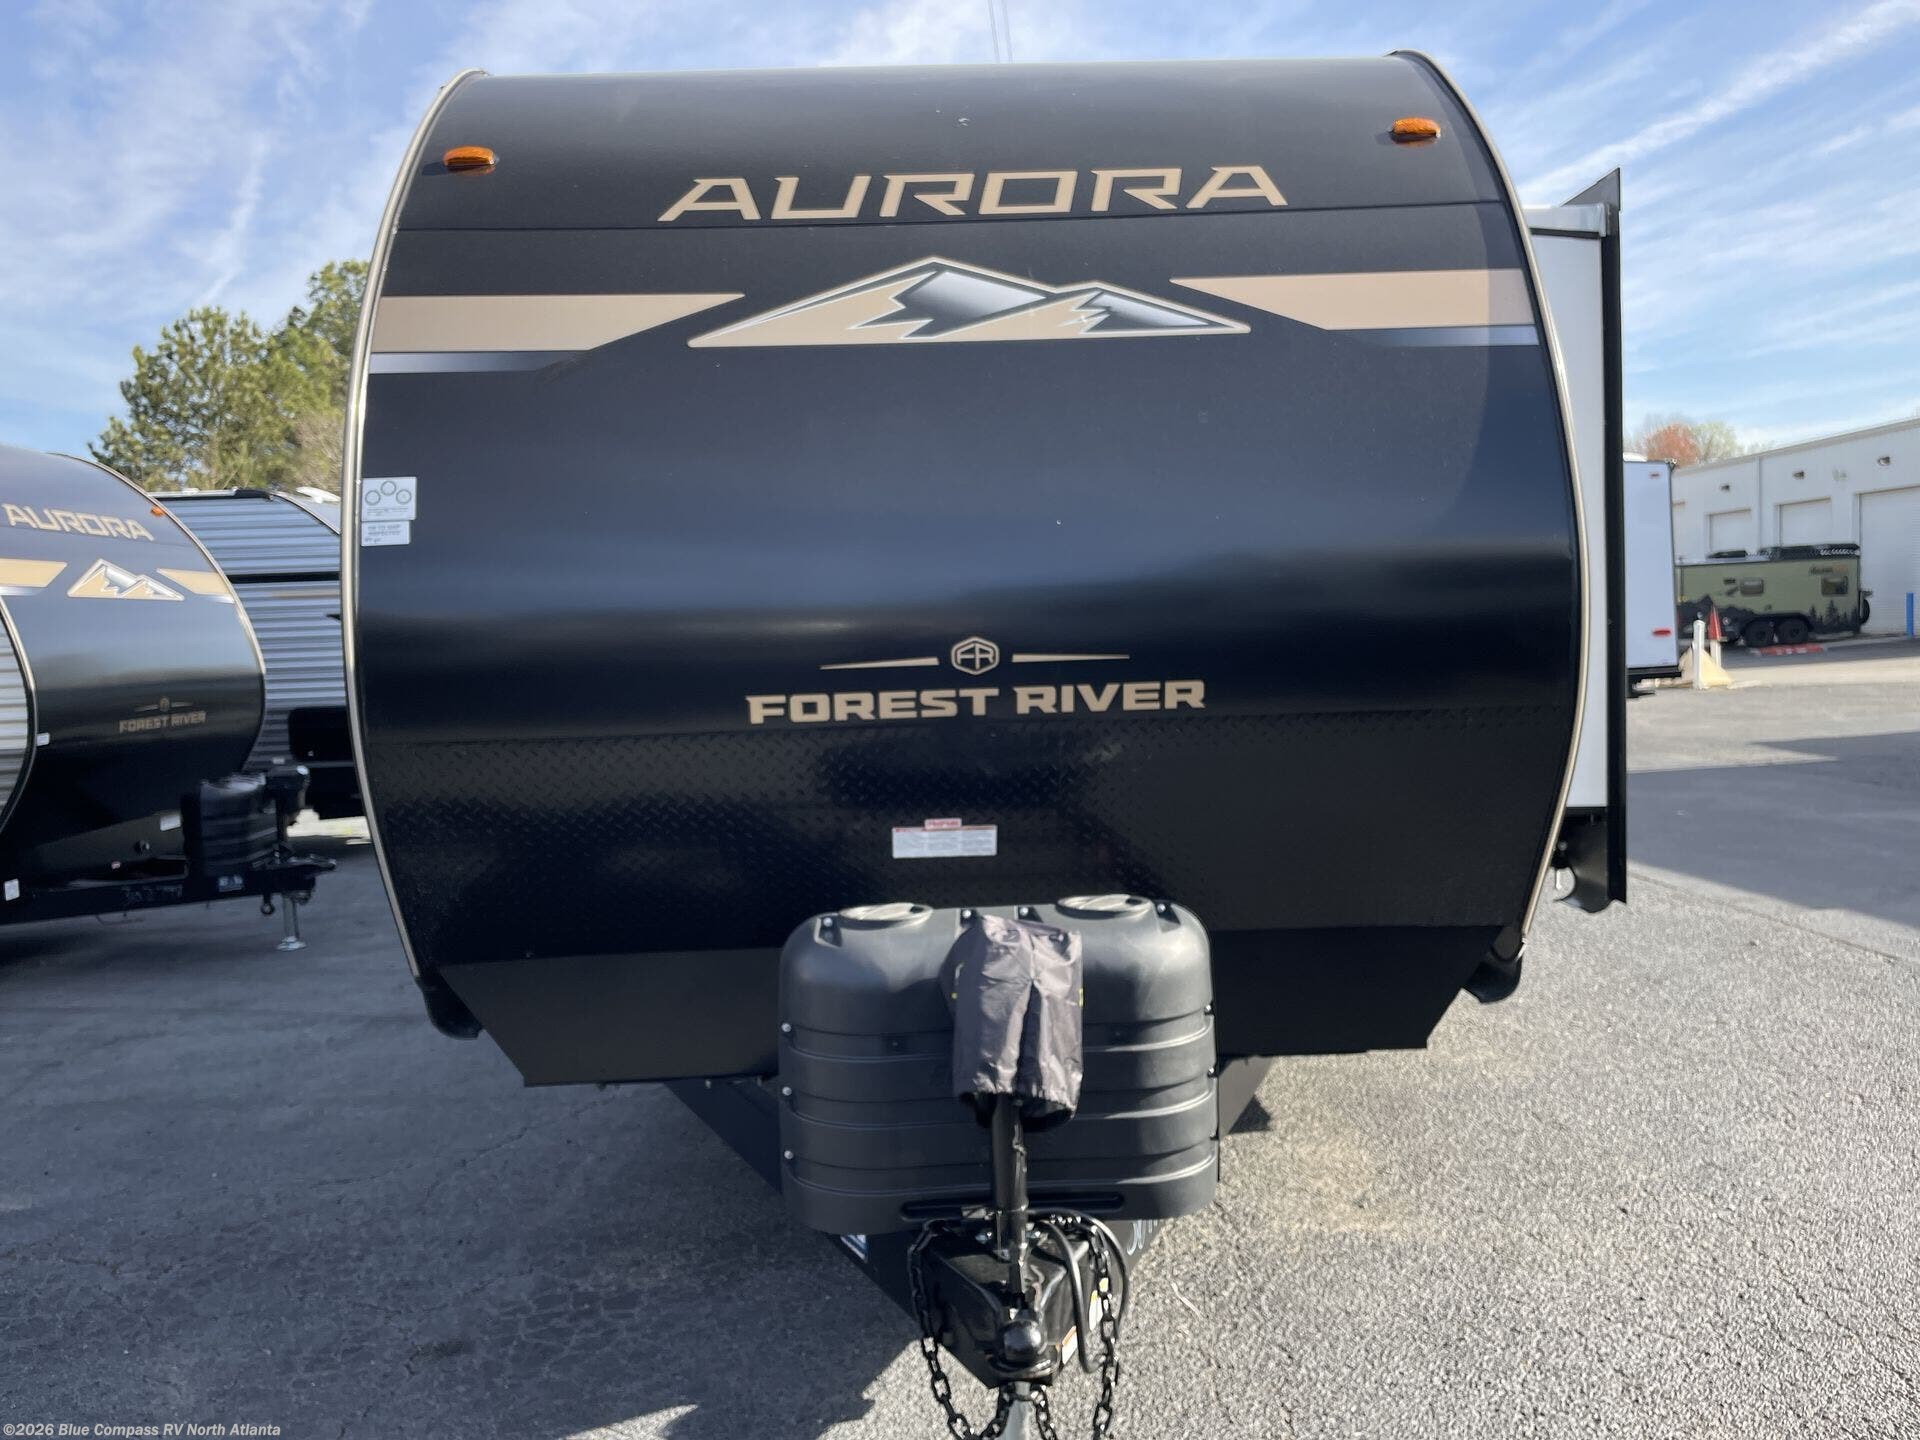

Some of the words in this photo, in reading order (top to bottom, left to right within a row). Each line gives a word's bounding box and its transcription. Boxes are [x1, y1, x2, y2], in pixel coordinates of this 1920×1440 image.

[657, 165, 1289, 222] AURORA
[1, 503, 154, 542] AURORA
[119, 715, 170, 733] FOREST
[171, 709, 207, 727] RIVER
[745, 687, 1000, 725] FOREST
[1011, 680, 1206, 715] RIVER
